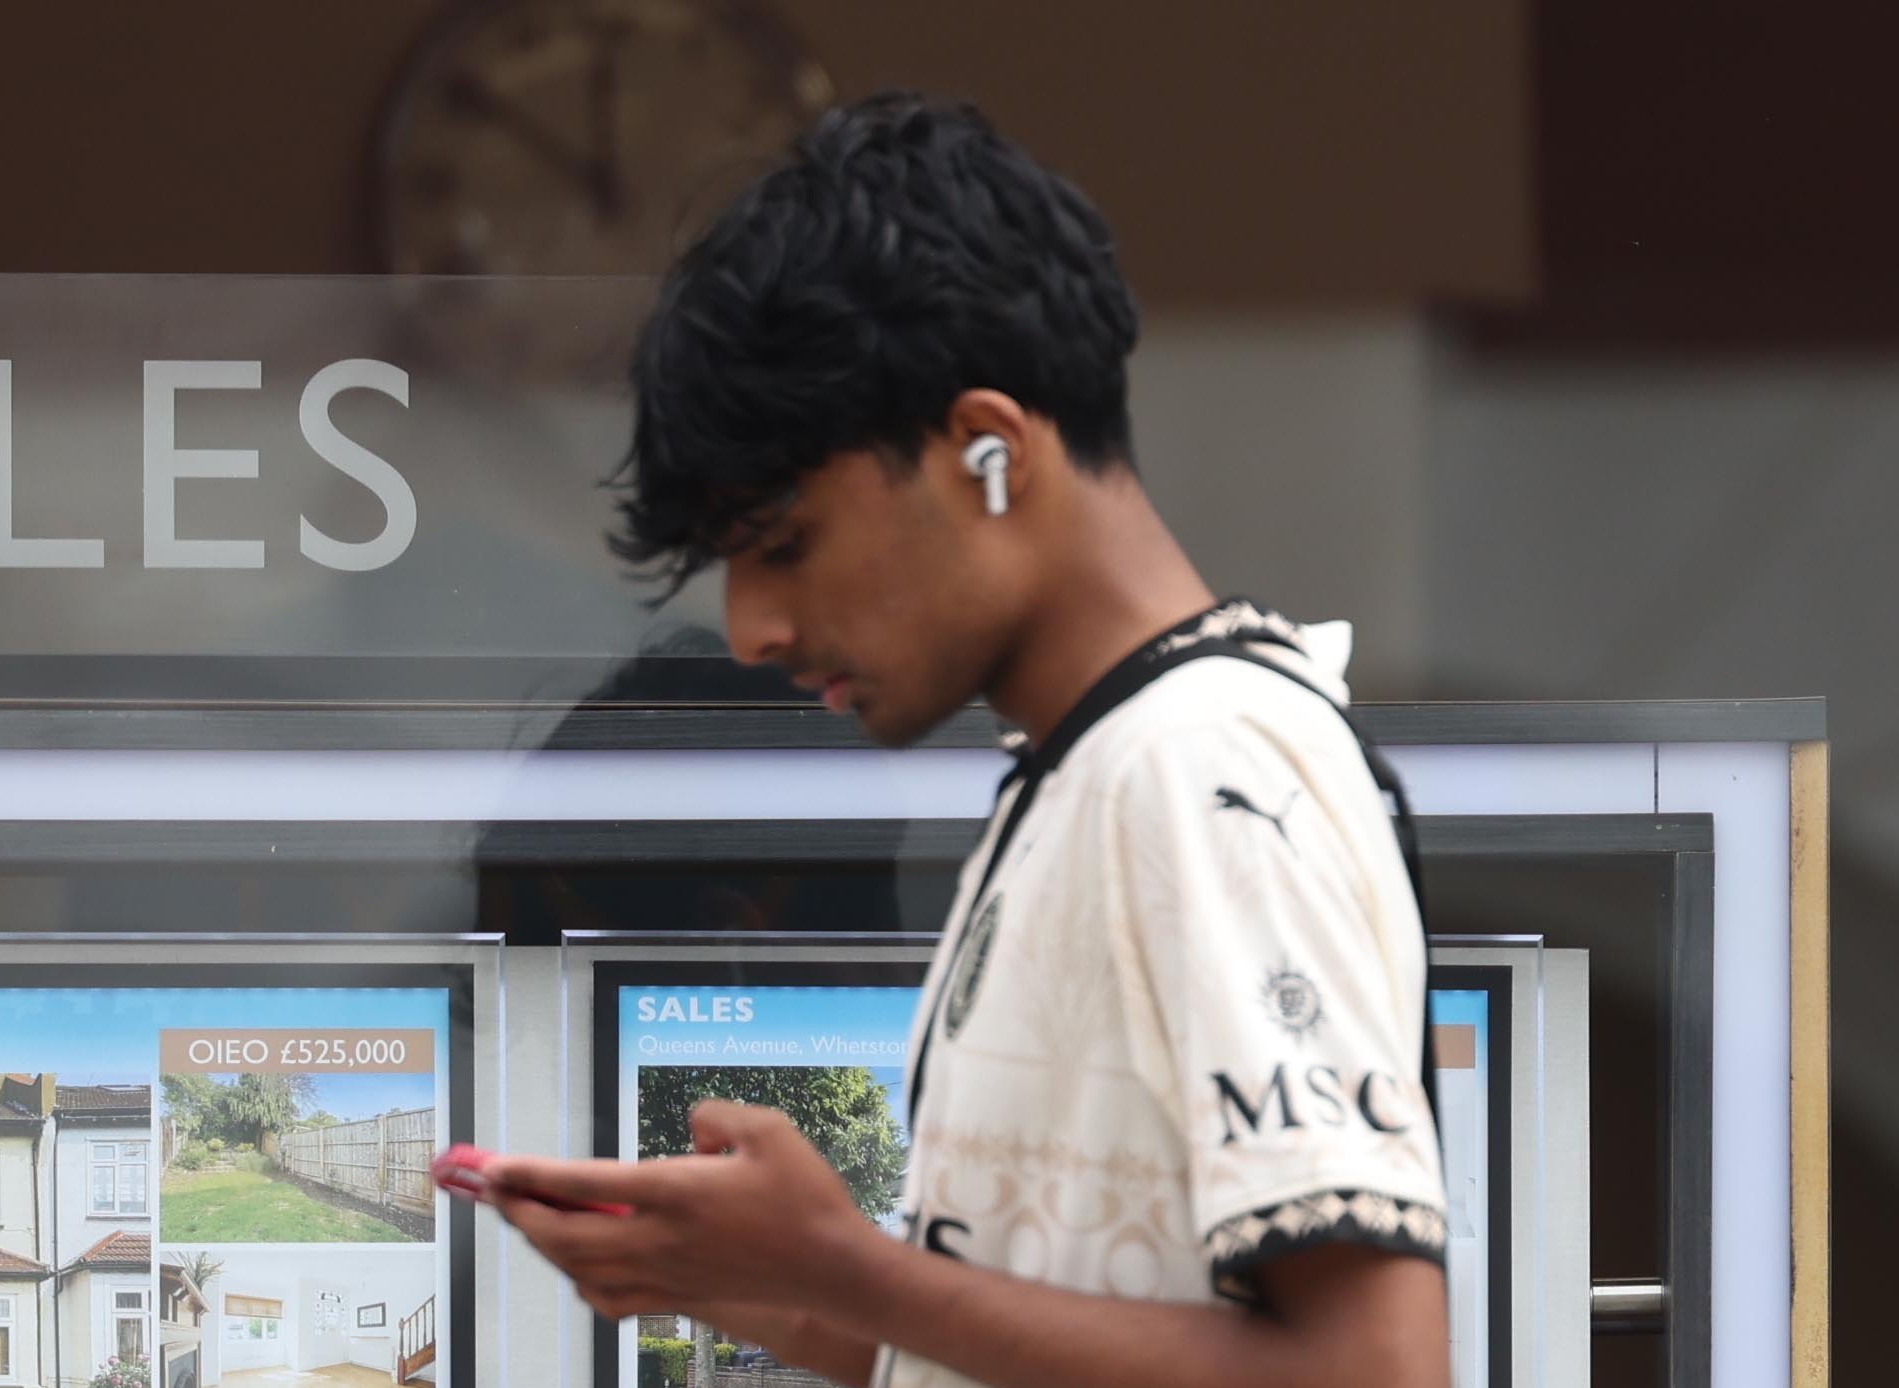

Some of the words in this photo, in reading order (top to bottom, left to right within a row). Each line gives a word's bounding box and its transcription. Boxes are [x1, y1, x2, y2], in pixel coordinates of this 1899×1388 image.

[638, 996, 753, 1022] SALES
[189, 1039, 268, 1064] OIEO
[280, 1039, 406, 1067] £525,000
[638, 1035, 716, 1056] Queens
[1209, 1061, 1411, 1147] MSC
